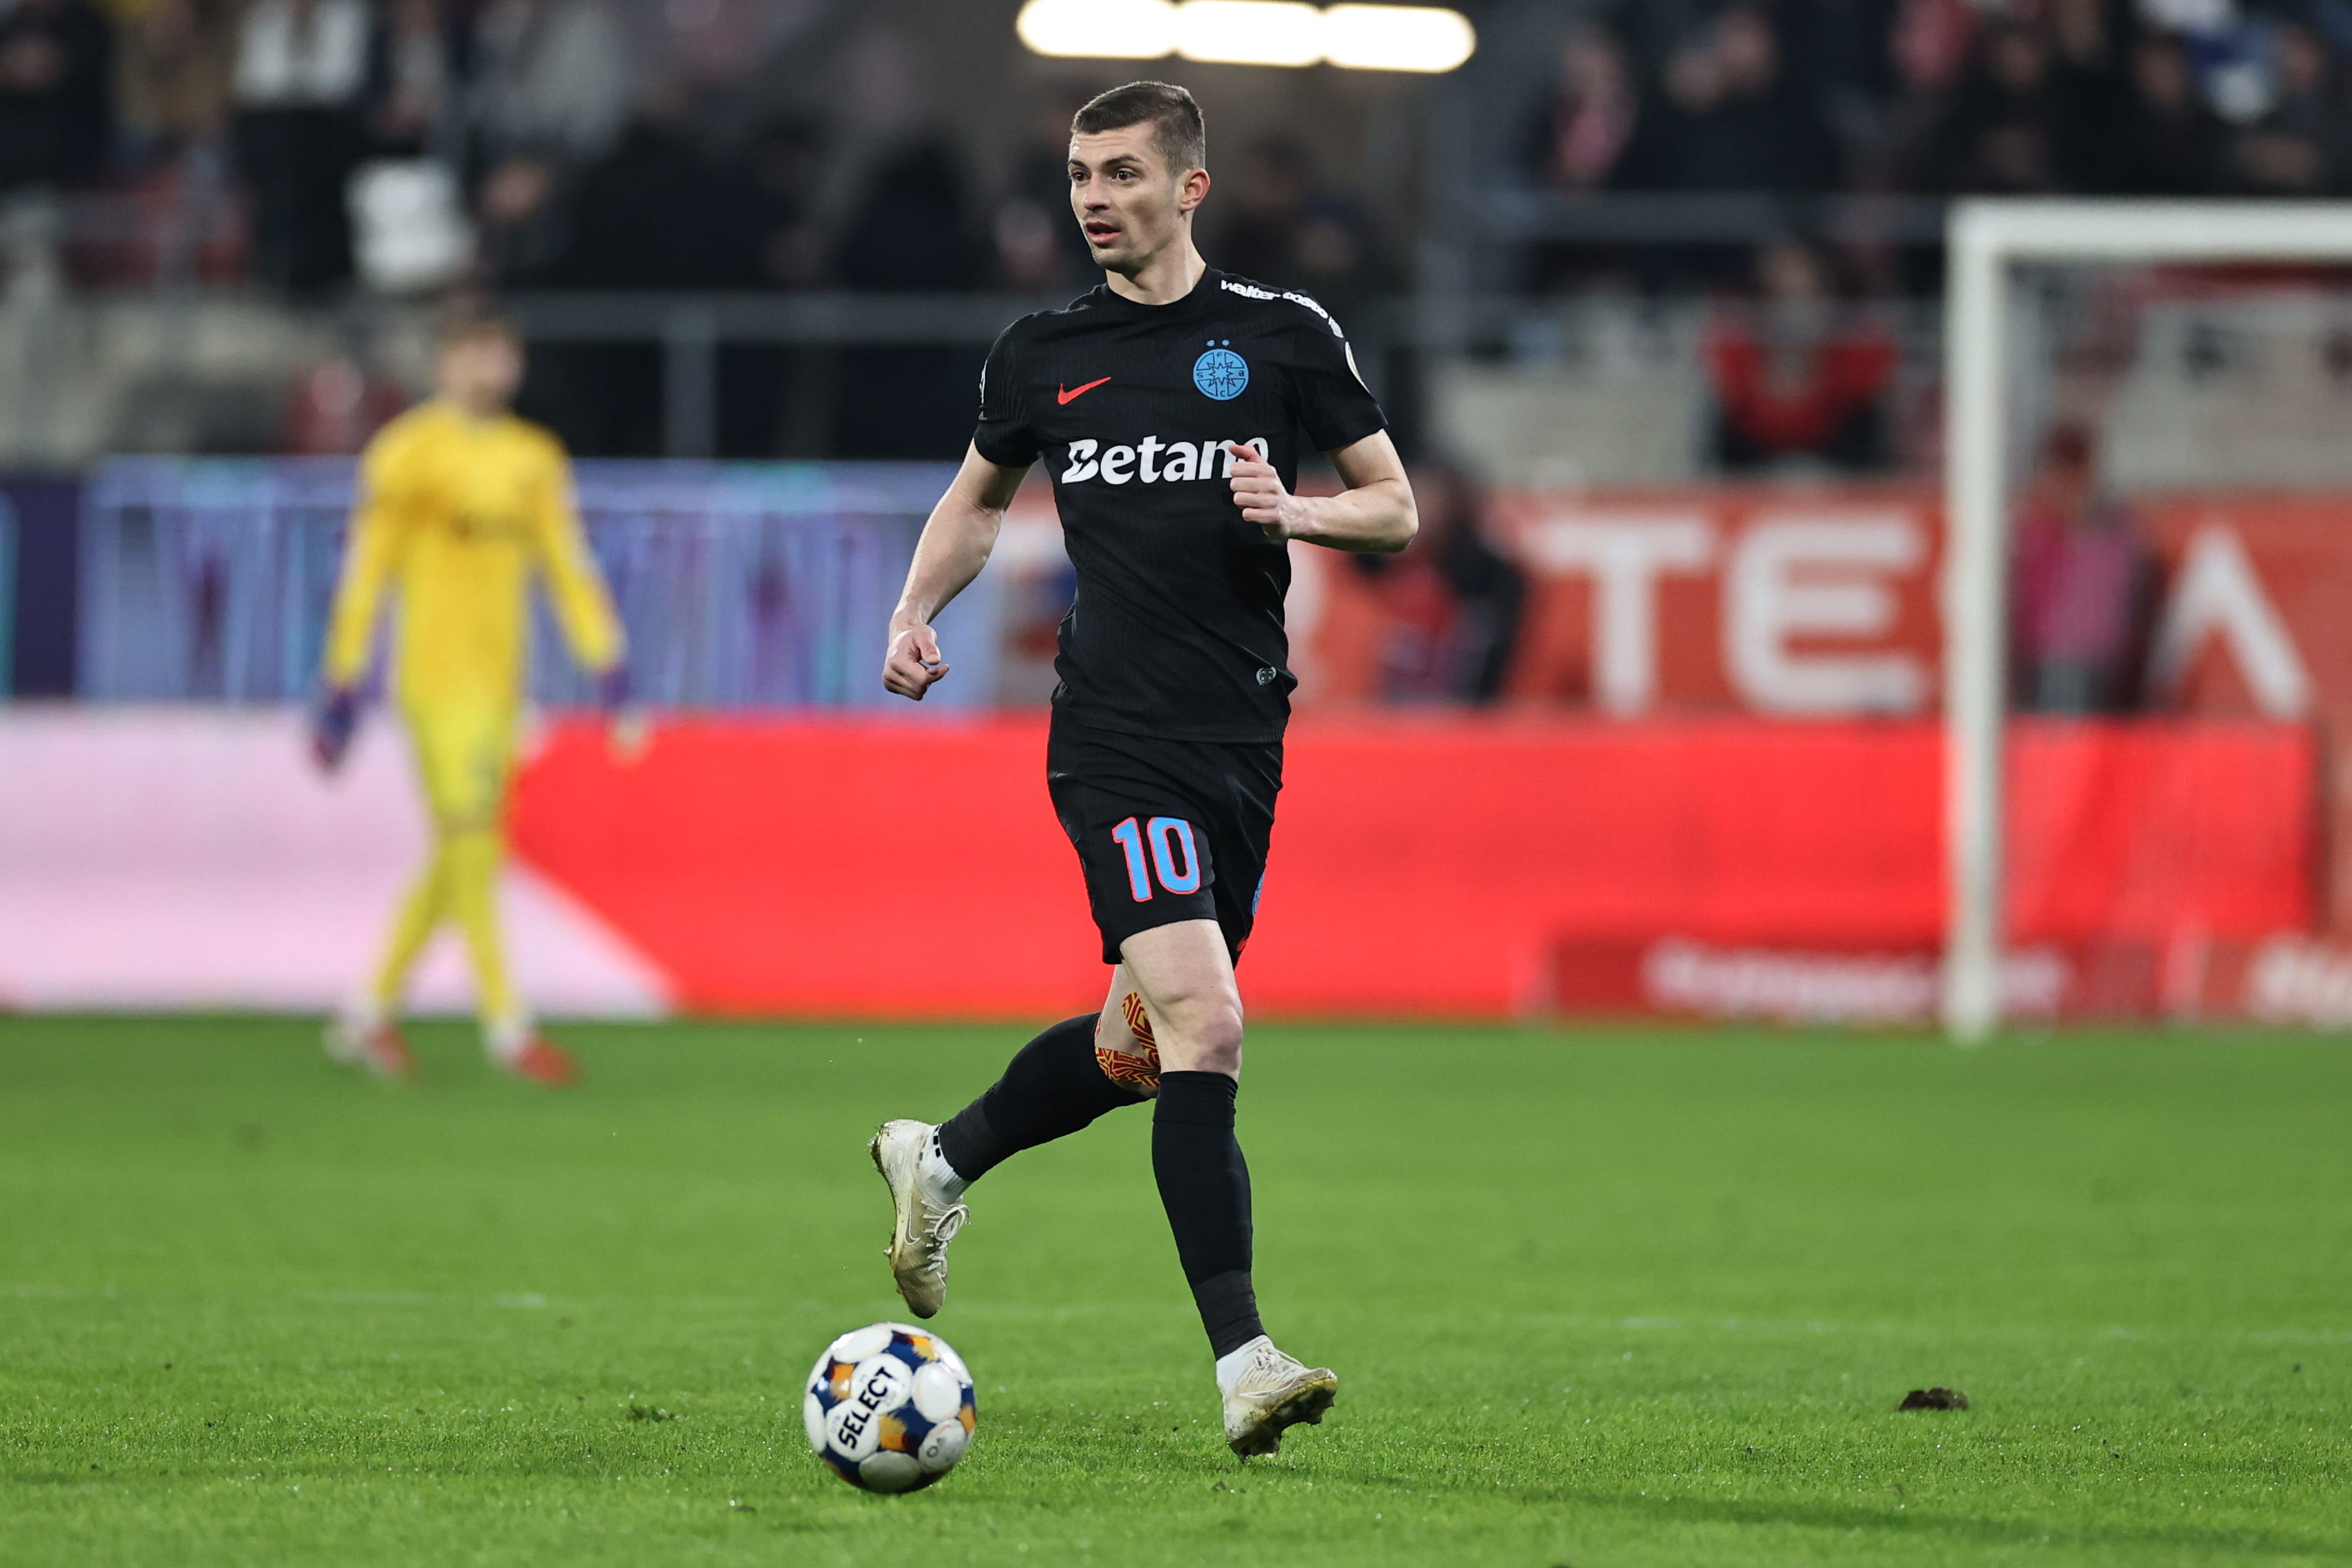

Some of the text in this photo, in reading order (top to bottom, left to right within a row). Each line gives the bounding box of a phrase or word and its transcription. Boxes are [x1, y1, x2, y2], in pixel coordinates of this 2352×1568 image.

[1221, 280, 1281, 300] walter
[1112, 816, 1201, 902] 10
[838, 1367, 895, 1449] SELECT
